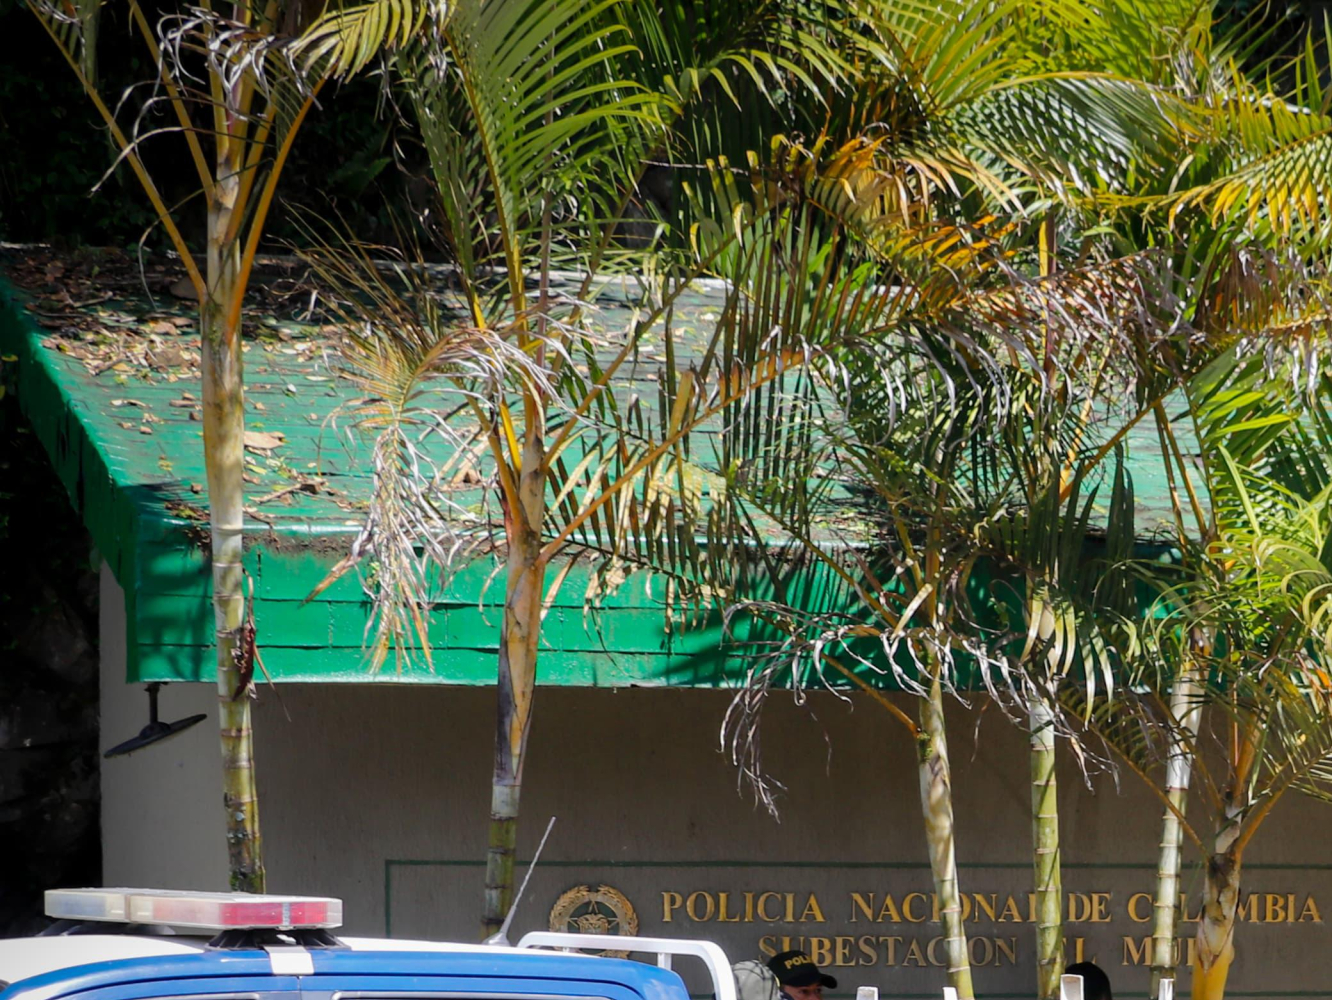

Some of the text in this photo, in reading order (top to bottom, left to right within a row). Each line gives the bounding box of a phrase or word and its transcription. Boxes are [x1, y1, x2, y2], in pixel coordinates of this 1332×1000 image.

[662, 891, 826, 923] POLICIA
[1068, 892, 1111, 923] DE
[1127, 892, 1322, 923] CLMBIA
[758, 935, 1017, 967] SUBESTACON
